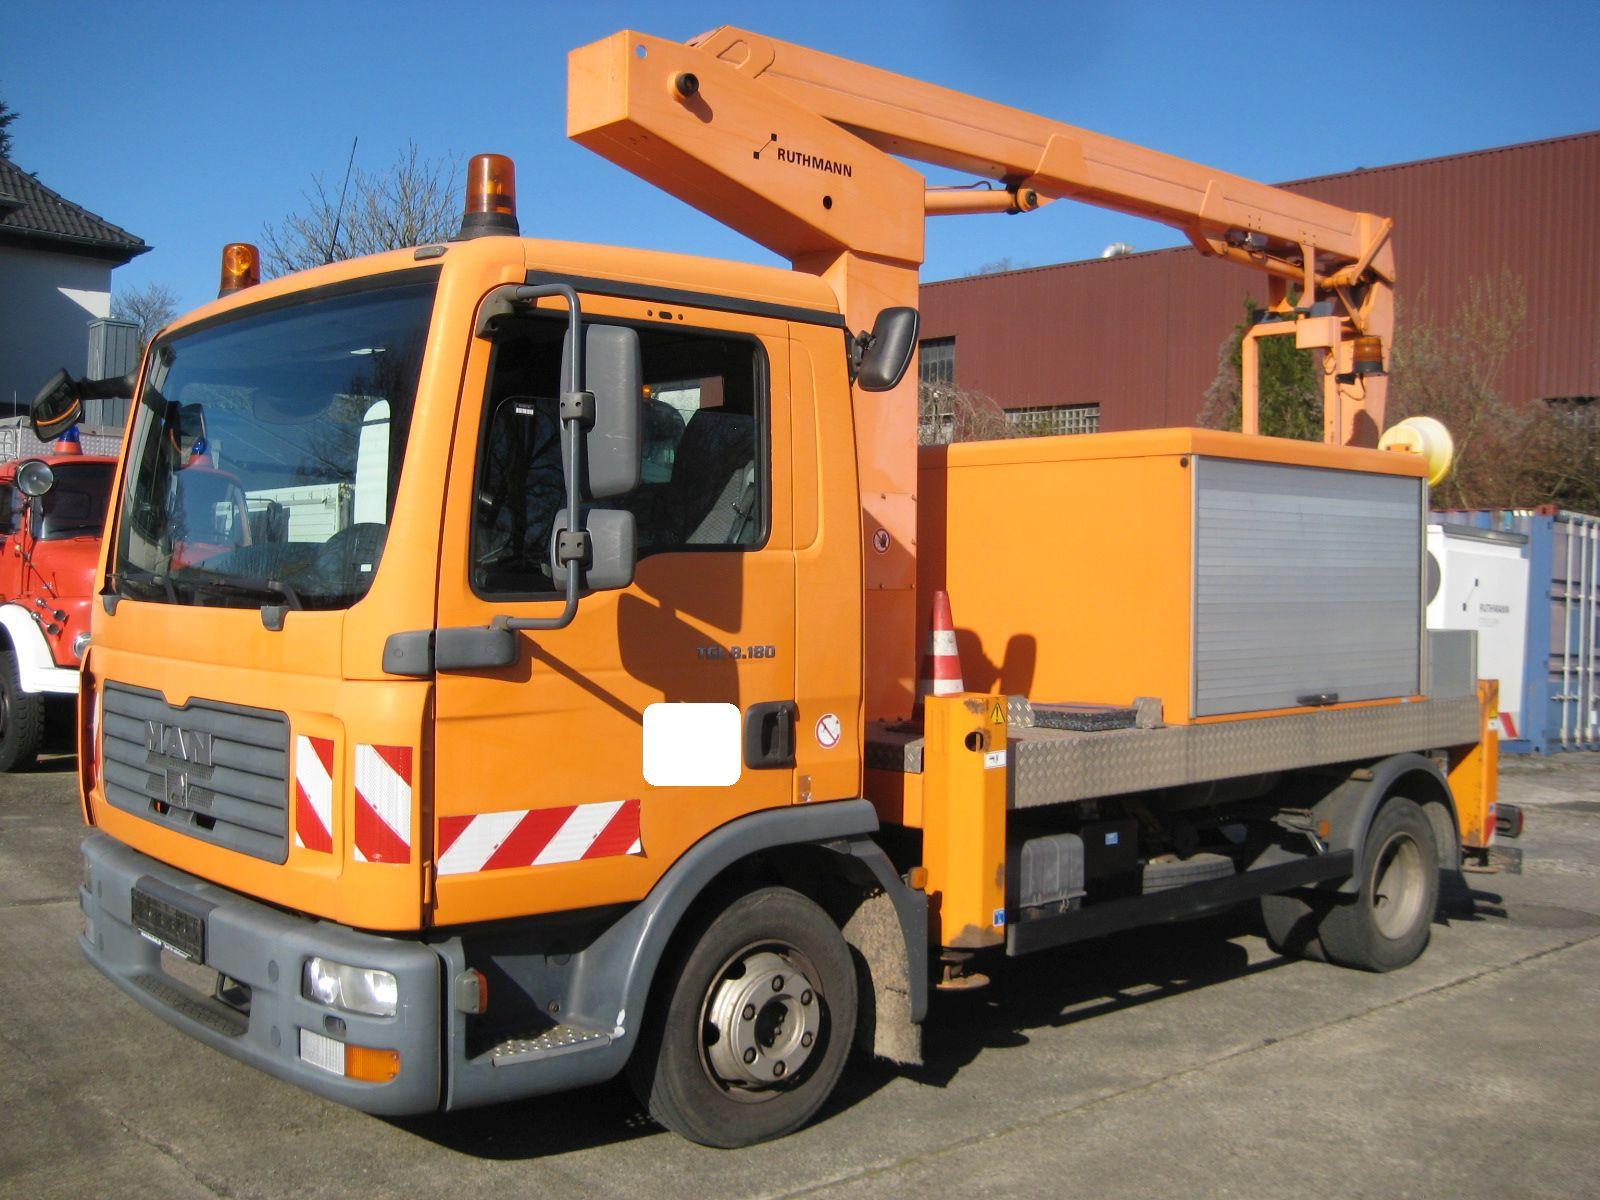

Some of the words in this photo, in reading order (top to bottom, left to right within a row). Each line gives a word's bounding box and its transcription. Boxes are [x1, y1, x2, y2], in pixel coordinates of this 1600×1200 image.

[777, 147, 852, 178] RUTHMANN
[729, 645, 776, 660] 8.180
[145, 720, 213, 768] MAN
